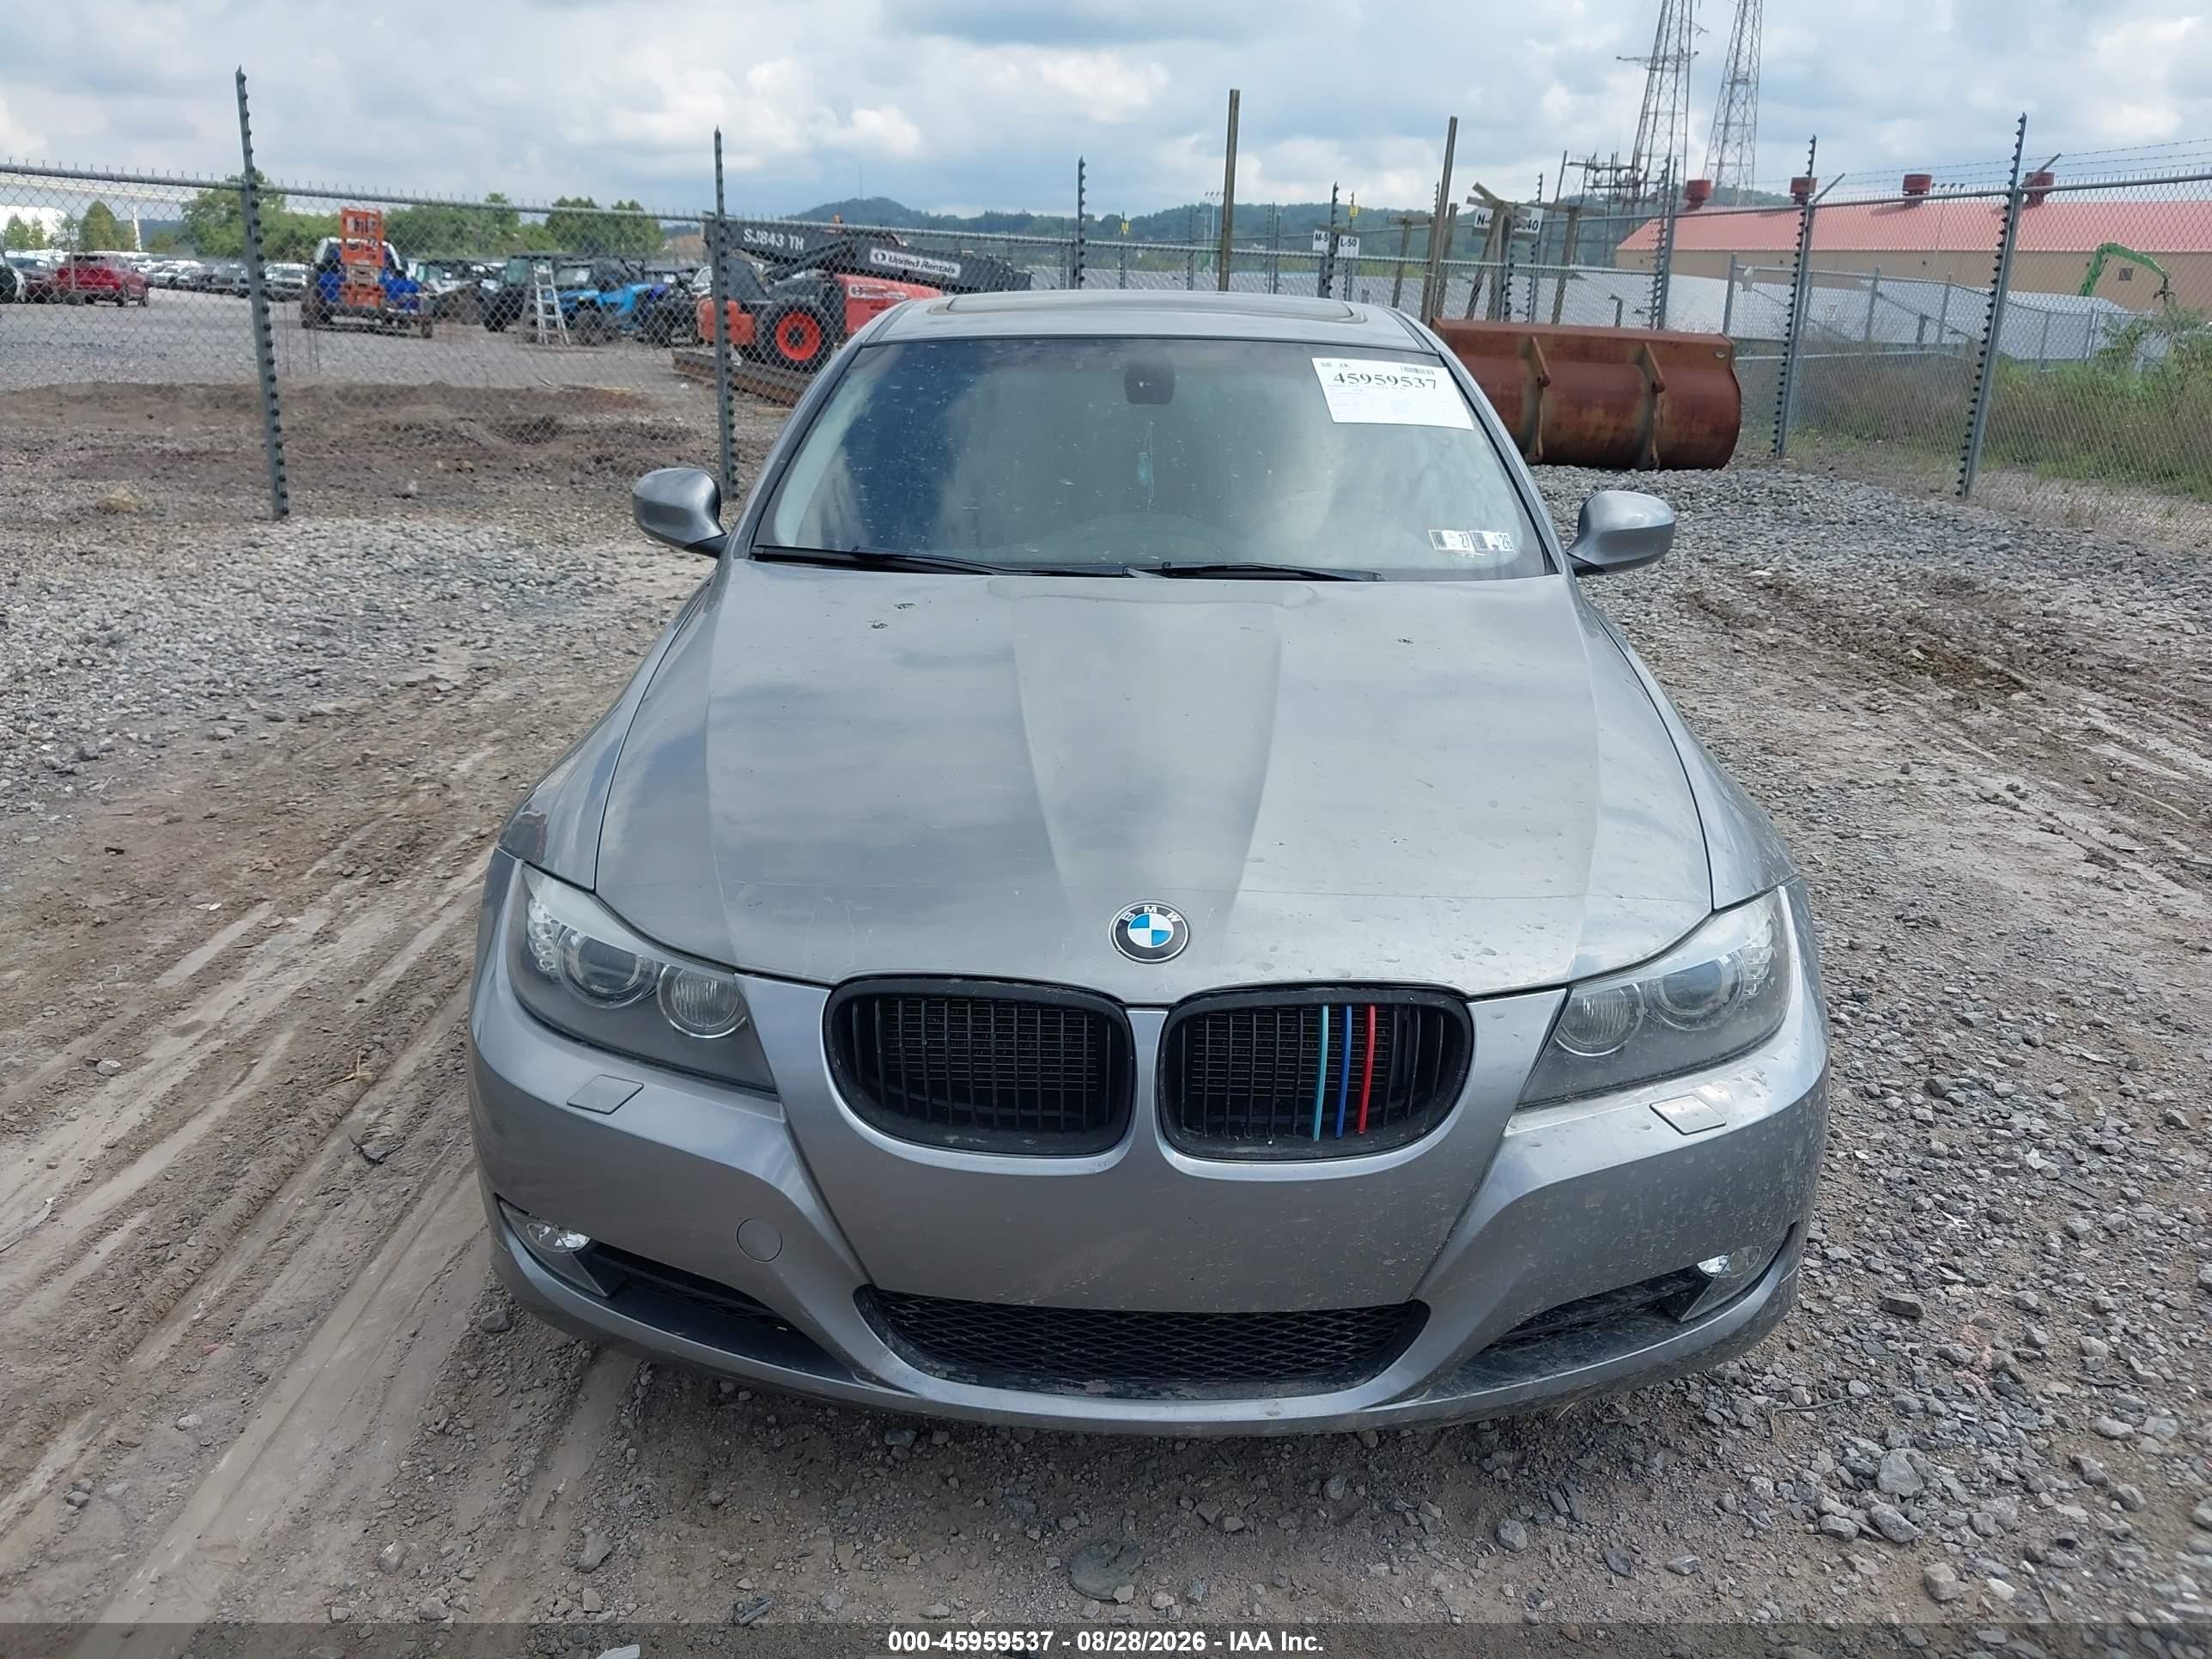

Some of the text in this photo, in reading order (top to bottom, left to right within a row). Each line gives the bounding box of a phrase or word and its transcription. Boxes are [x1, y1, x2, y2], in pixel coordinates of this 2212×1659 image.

[743, 228, 805, 251] SJ843 TH
[1315, 233, 1329, 242] M-5
[1340, 238, 1358, 247] L-50
[888, 253, 956, 274] United Rentals
[1333, 372, 1437, 390] 45959537
[1498, 534, 1513, 550] 26
[1121, 906, 1182, 923] BMW
